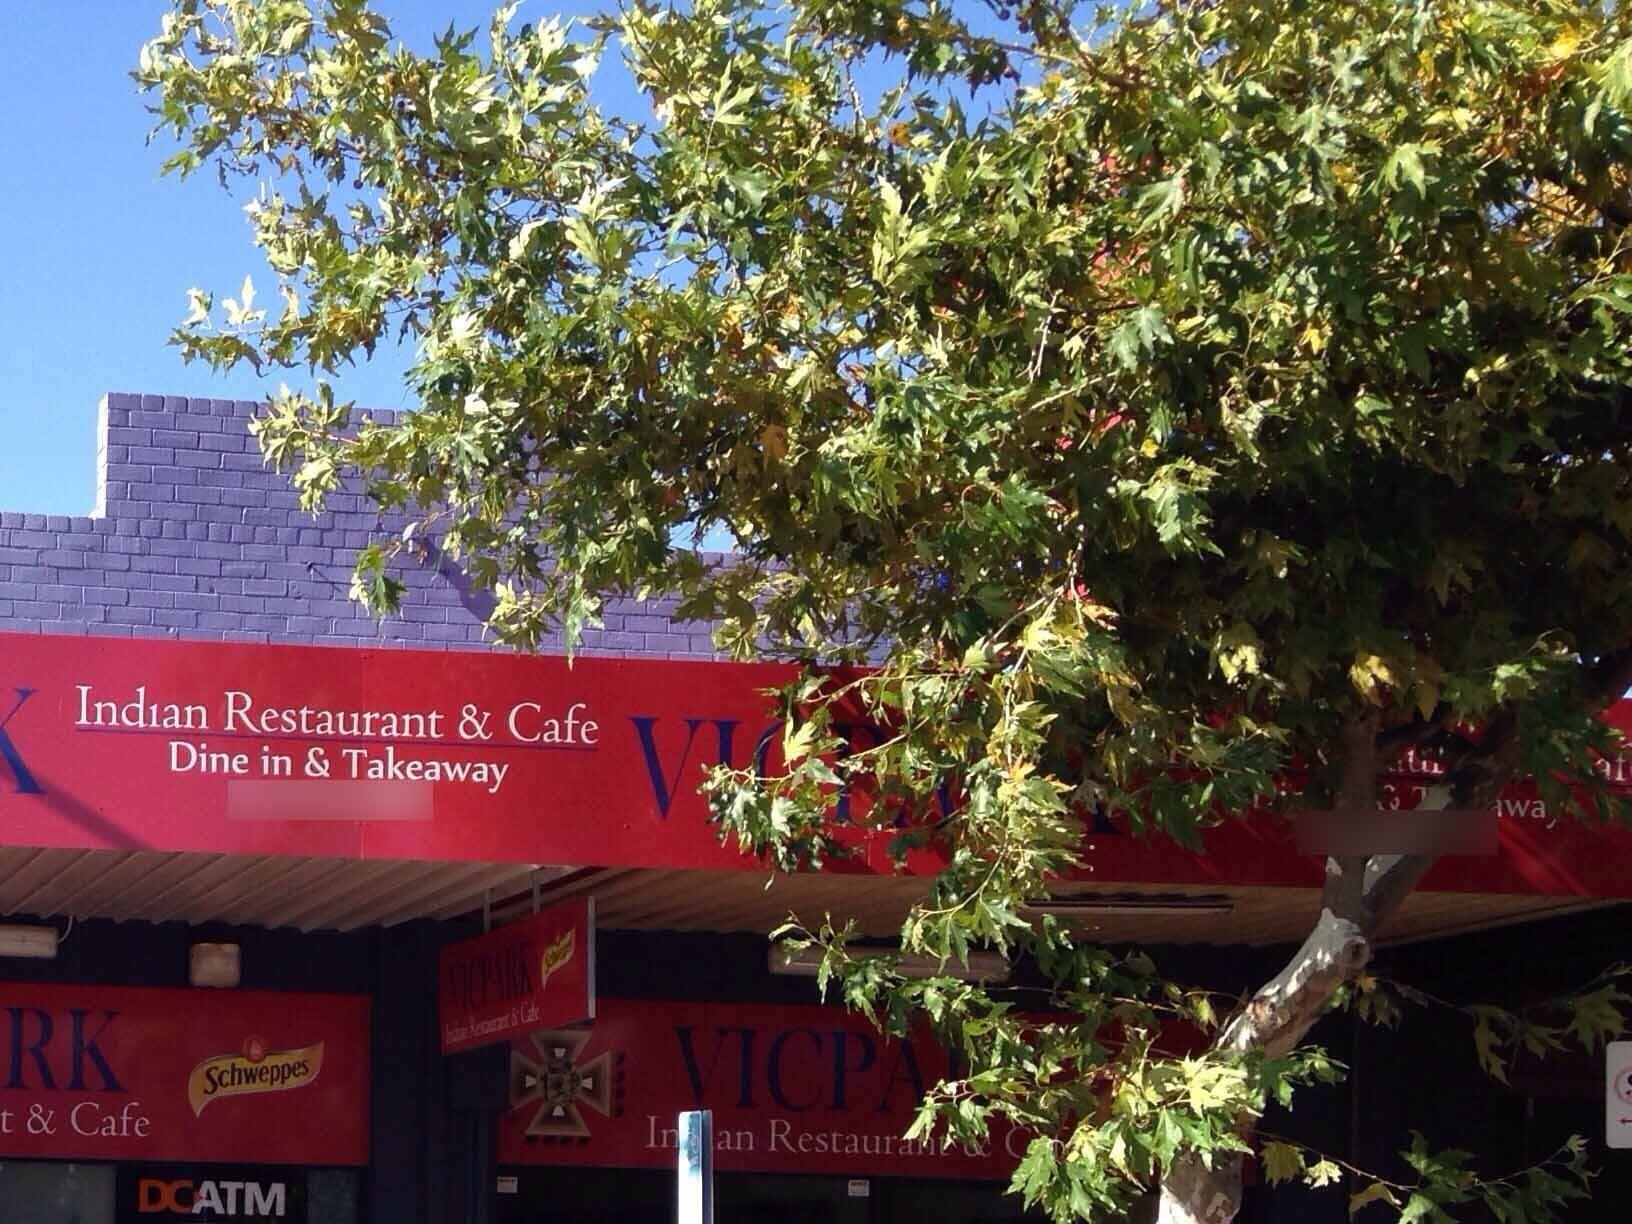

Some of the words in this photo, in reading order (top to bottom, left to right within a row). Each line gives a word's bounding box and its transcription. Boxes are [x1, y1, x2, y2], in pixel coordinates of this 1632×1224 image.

[75, 685, 208, 730] Indian
[224, 691, 444, 738] Restaurant
[459, 704, 493, 740] &
[508, 702, 599, 745] Cafe
[169, 741, 248, 775] Dine
[262, 746, 292, 776] in
[304, 750, 330, 777] &
[343, 749, 509, 792] Takeaway
[204, 1059, 309, 1095] Schweppes
[26, 1103, 56, 1134] &
[70, 1100, 151, 1138] Cafe
[643, 1115, 755, 1152] Inan
